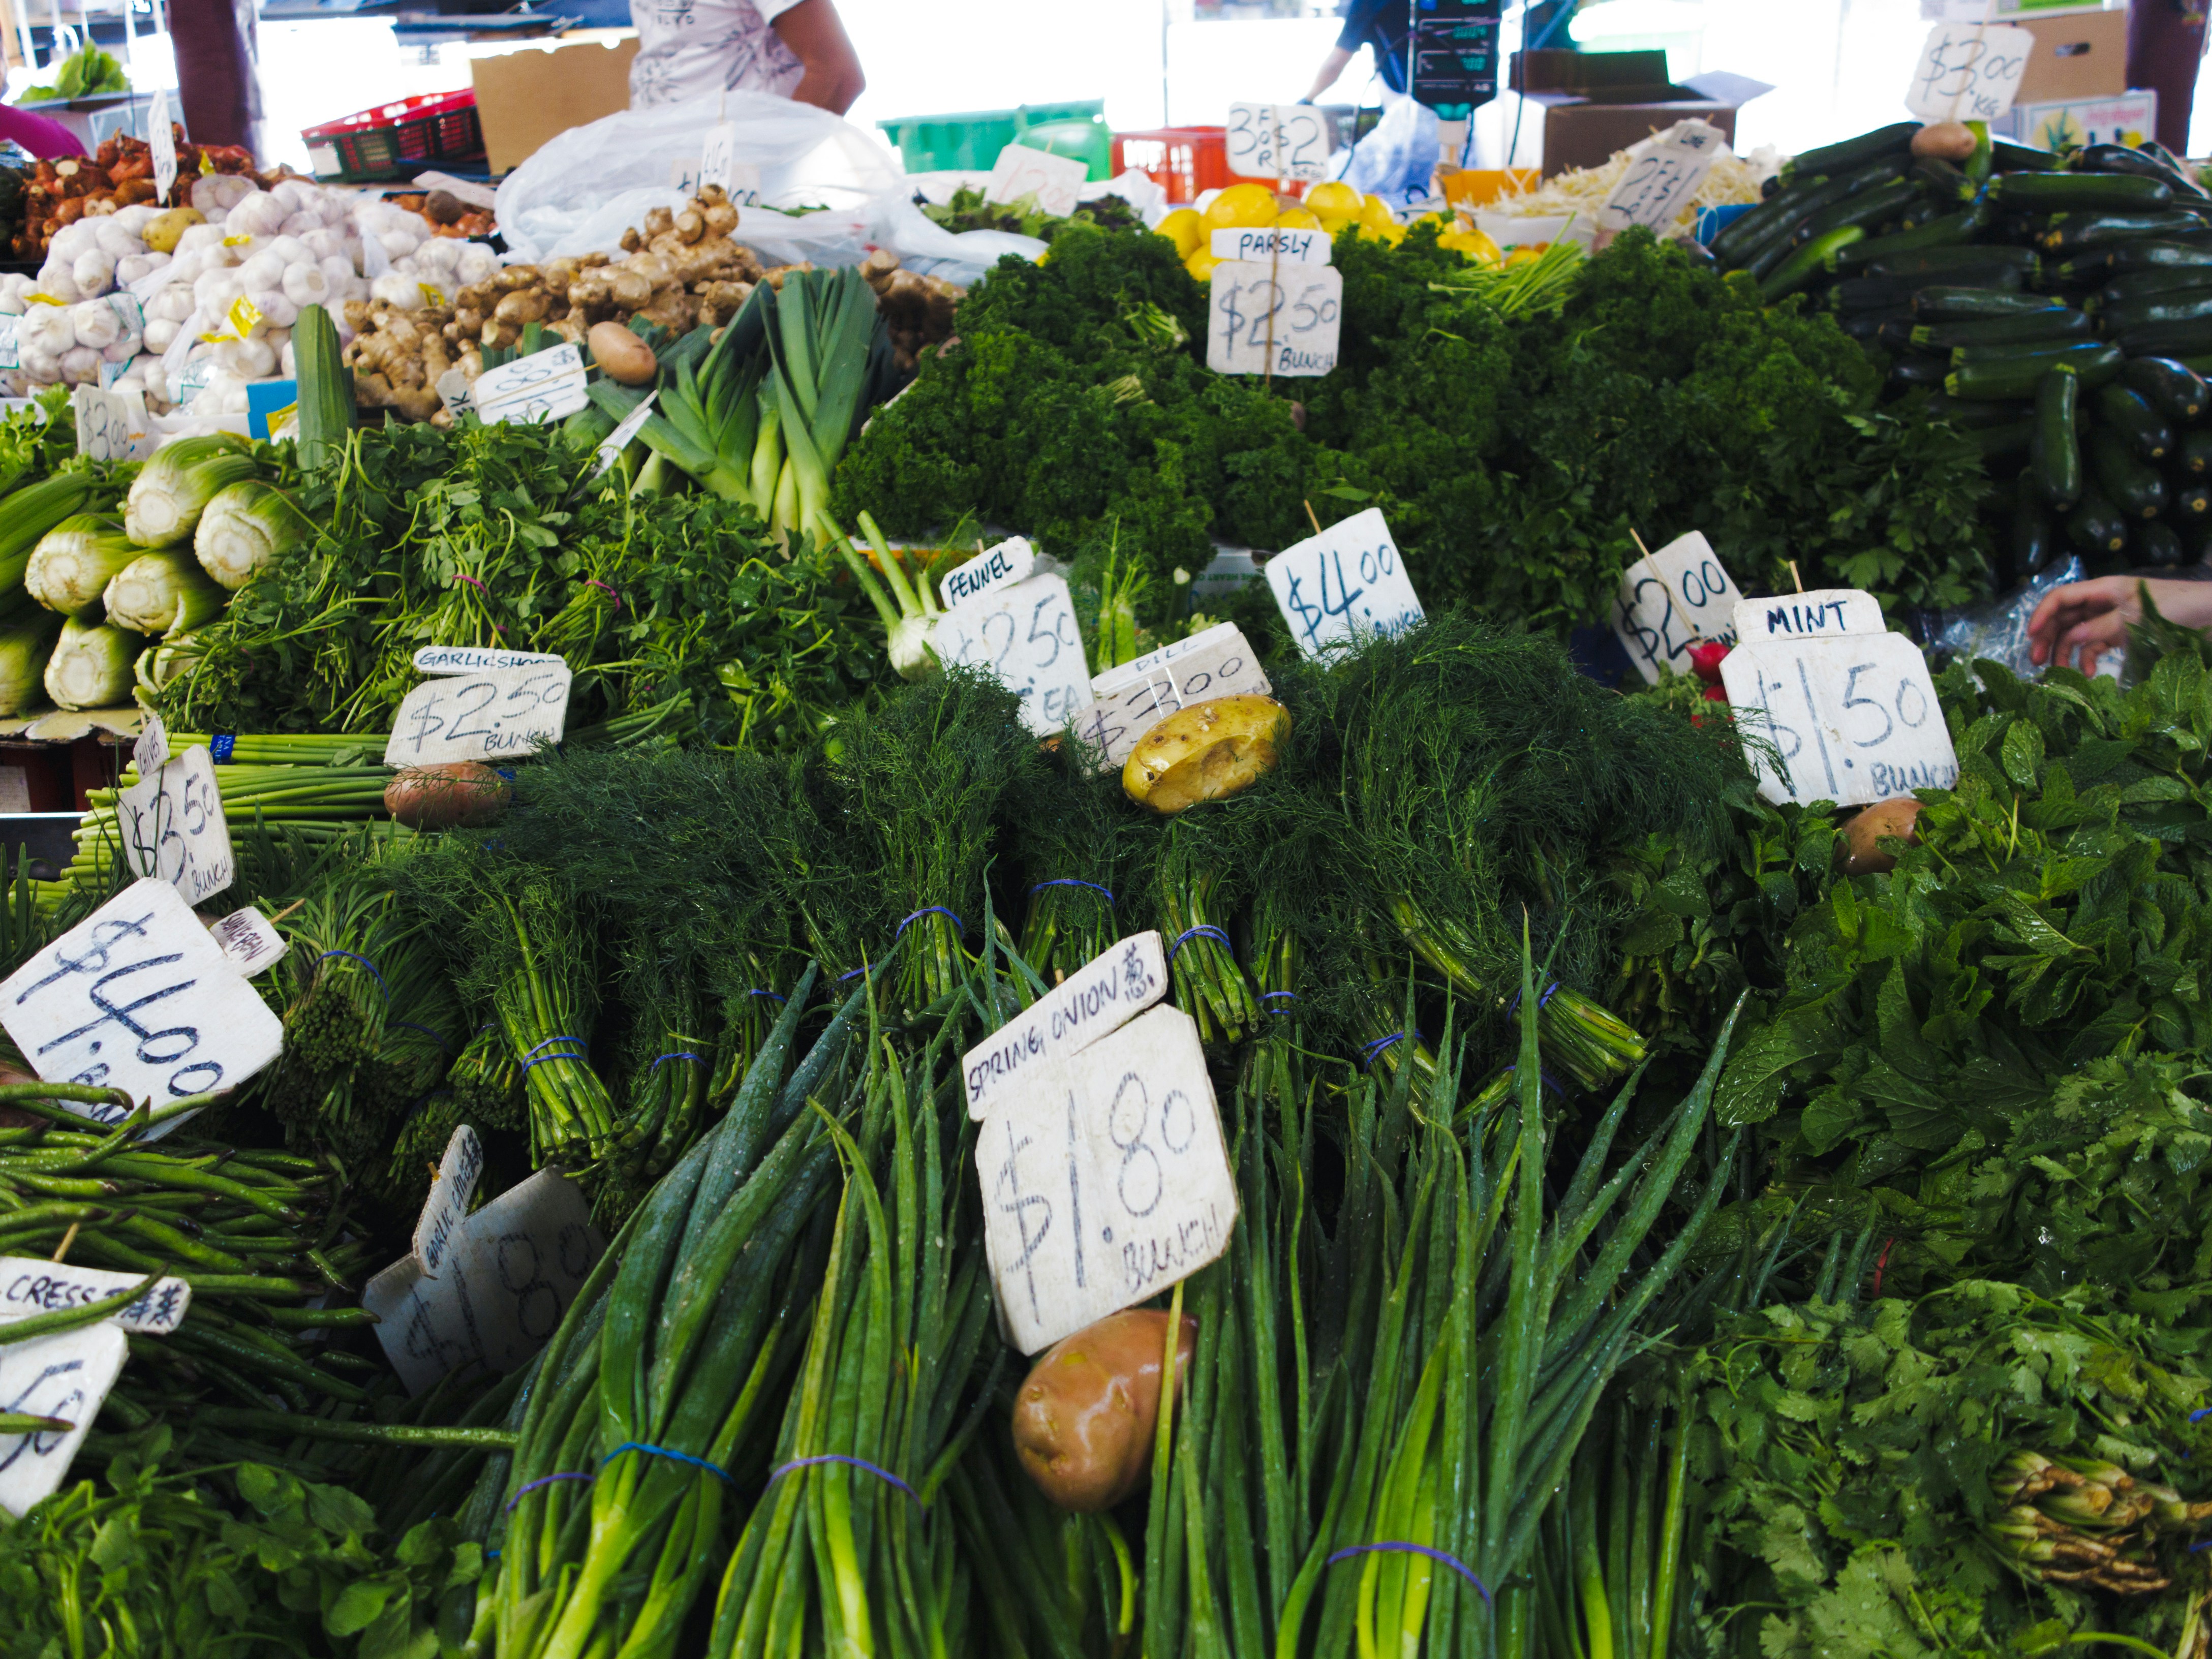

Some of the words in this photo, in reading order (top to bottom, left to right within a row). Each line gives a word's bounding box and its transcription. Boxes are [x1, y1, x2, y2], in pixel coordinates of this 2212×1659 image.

[1230, 107, 1257, 156] 3
[1239, 233, 1313, 261] PARSLY
[948, 549, 1014, 606] FENNEL
[1766, 600, 1848, 634] MINT
[1135, 640, 1199, 672] DILL
[407, 672, 566, 754] $2.50
[139, 731, 161, 776] CHIVES
[968, 1026, 1046, 1103] SPRING
[1051, 965, 1118, 1041] ONION
[425, 1207, 454, 1270] GARLIC
